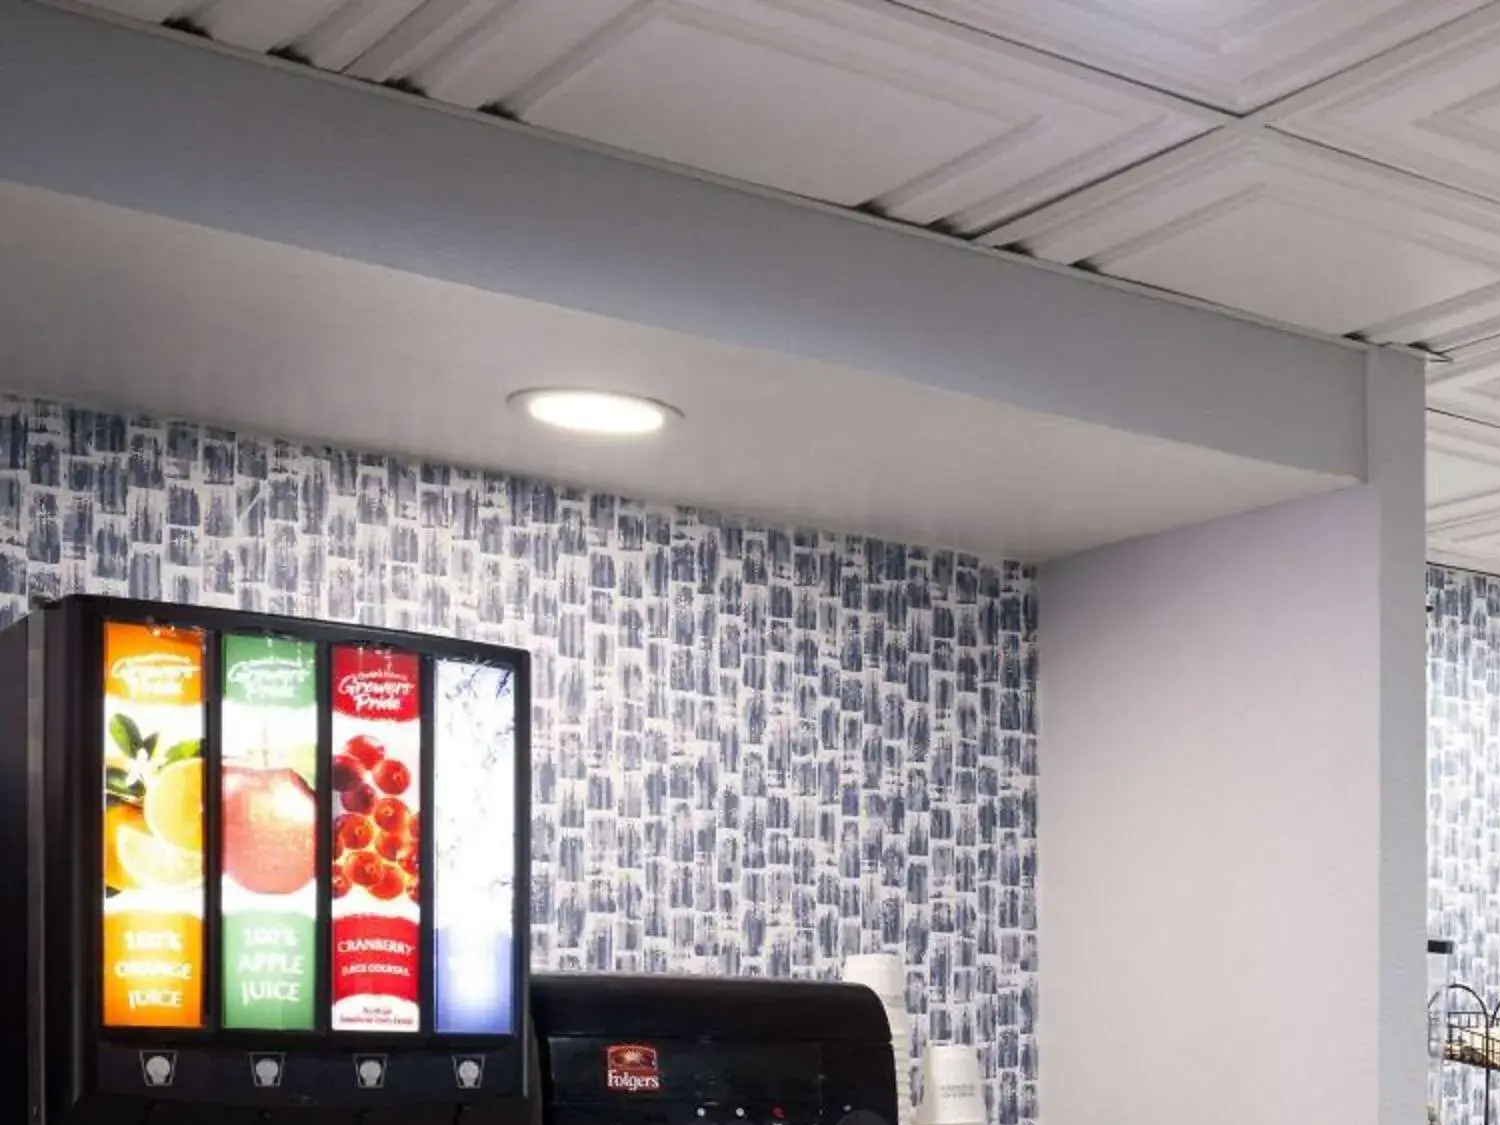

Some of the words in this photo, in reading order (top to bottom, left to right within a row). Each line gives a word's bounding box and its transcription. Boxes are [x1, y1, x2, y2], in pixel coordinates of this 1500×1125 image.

[337, 938, 414, 957] CRANBERRY
[238, 952, 305, 976] APPLE
[126, 988, 184, 1012] JUICE
[240, 979, 301, 1007] JUICE
[608, 1069, 660, 1091] Folgers
